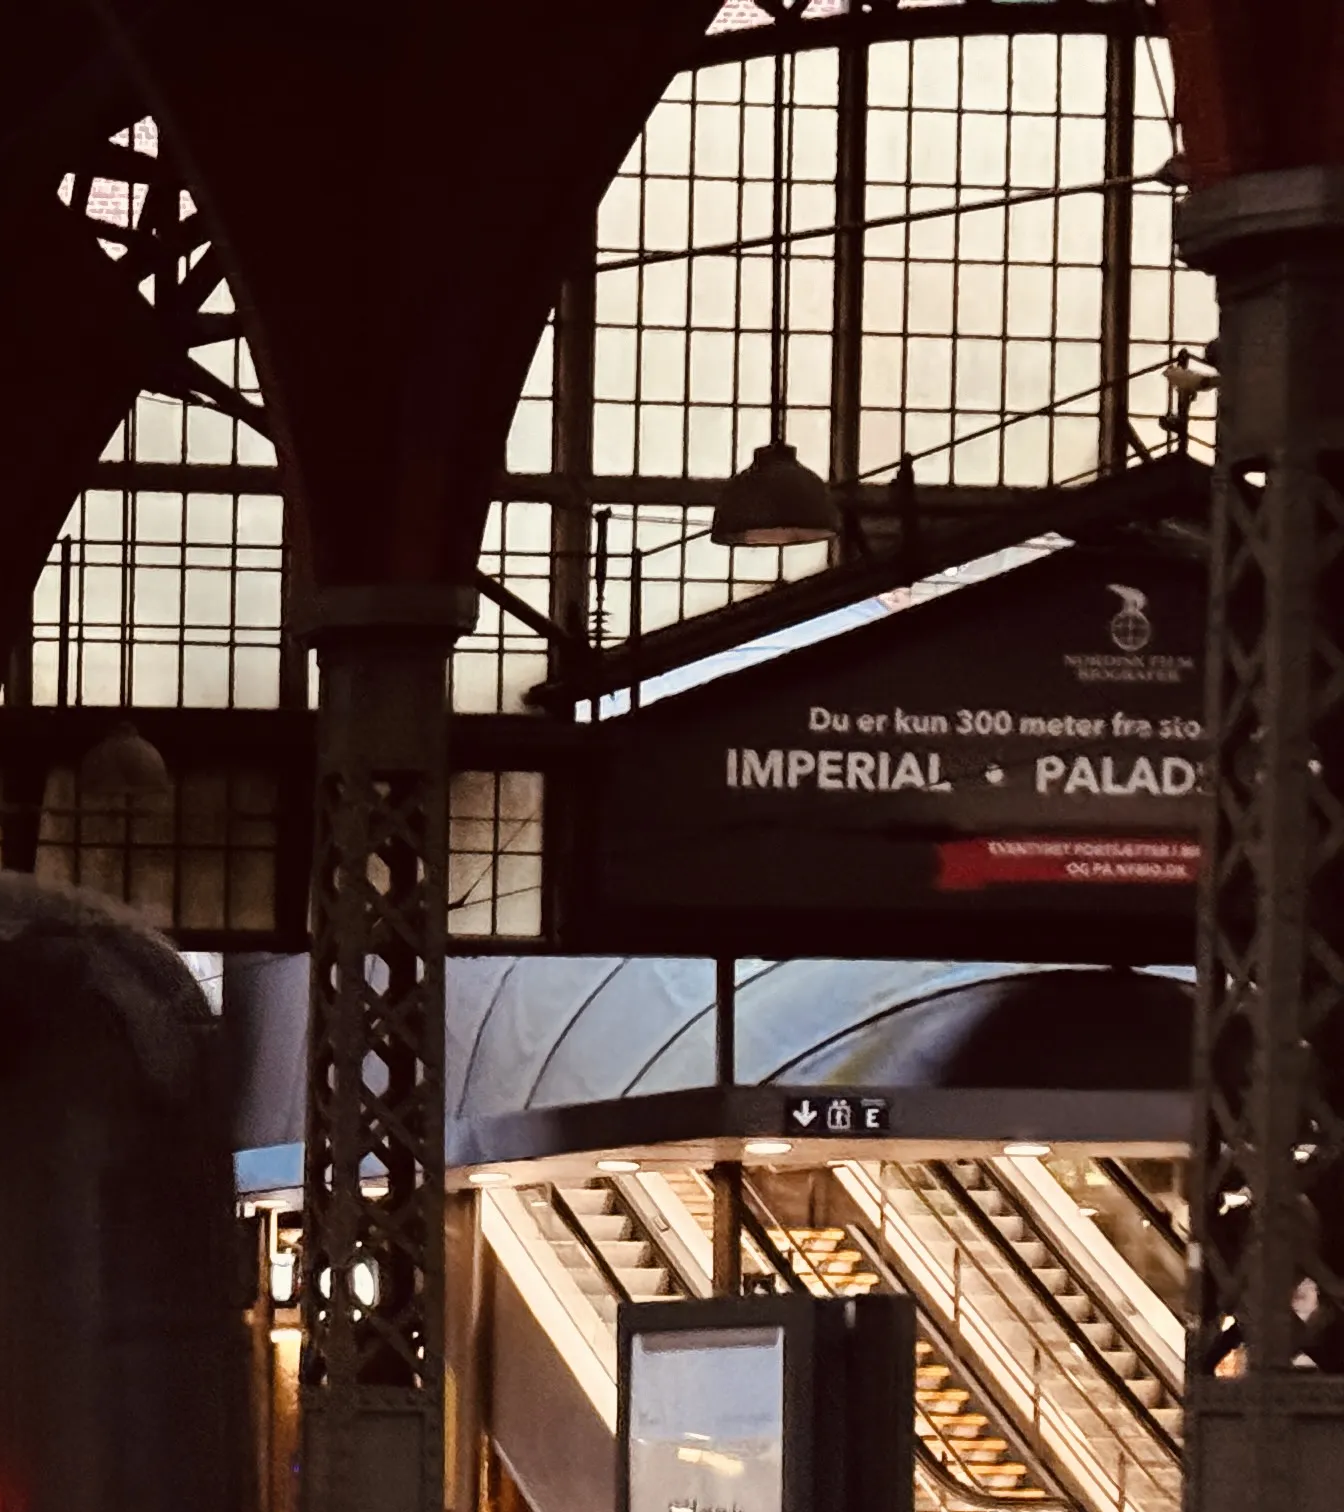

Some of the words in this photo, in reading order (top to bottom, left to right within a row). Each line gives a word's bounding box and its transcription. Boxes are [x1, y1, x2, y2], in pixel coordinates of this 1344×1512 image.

[810, 707, 849, 733] Du
[856, 713, 889, 734] er
[894, 707, 948, 735] kun
[955, 709, 1012, 736] 300
[1019, 714, 1109, 738] meter
[1158, 716, 1202, 740] sto
[725, 748, 952, 791] IMPERIAL
[1035, 754, 1205, 797] PALAD
[866, 1108, 880, 1128] E
